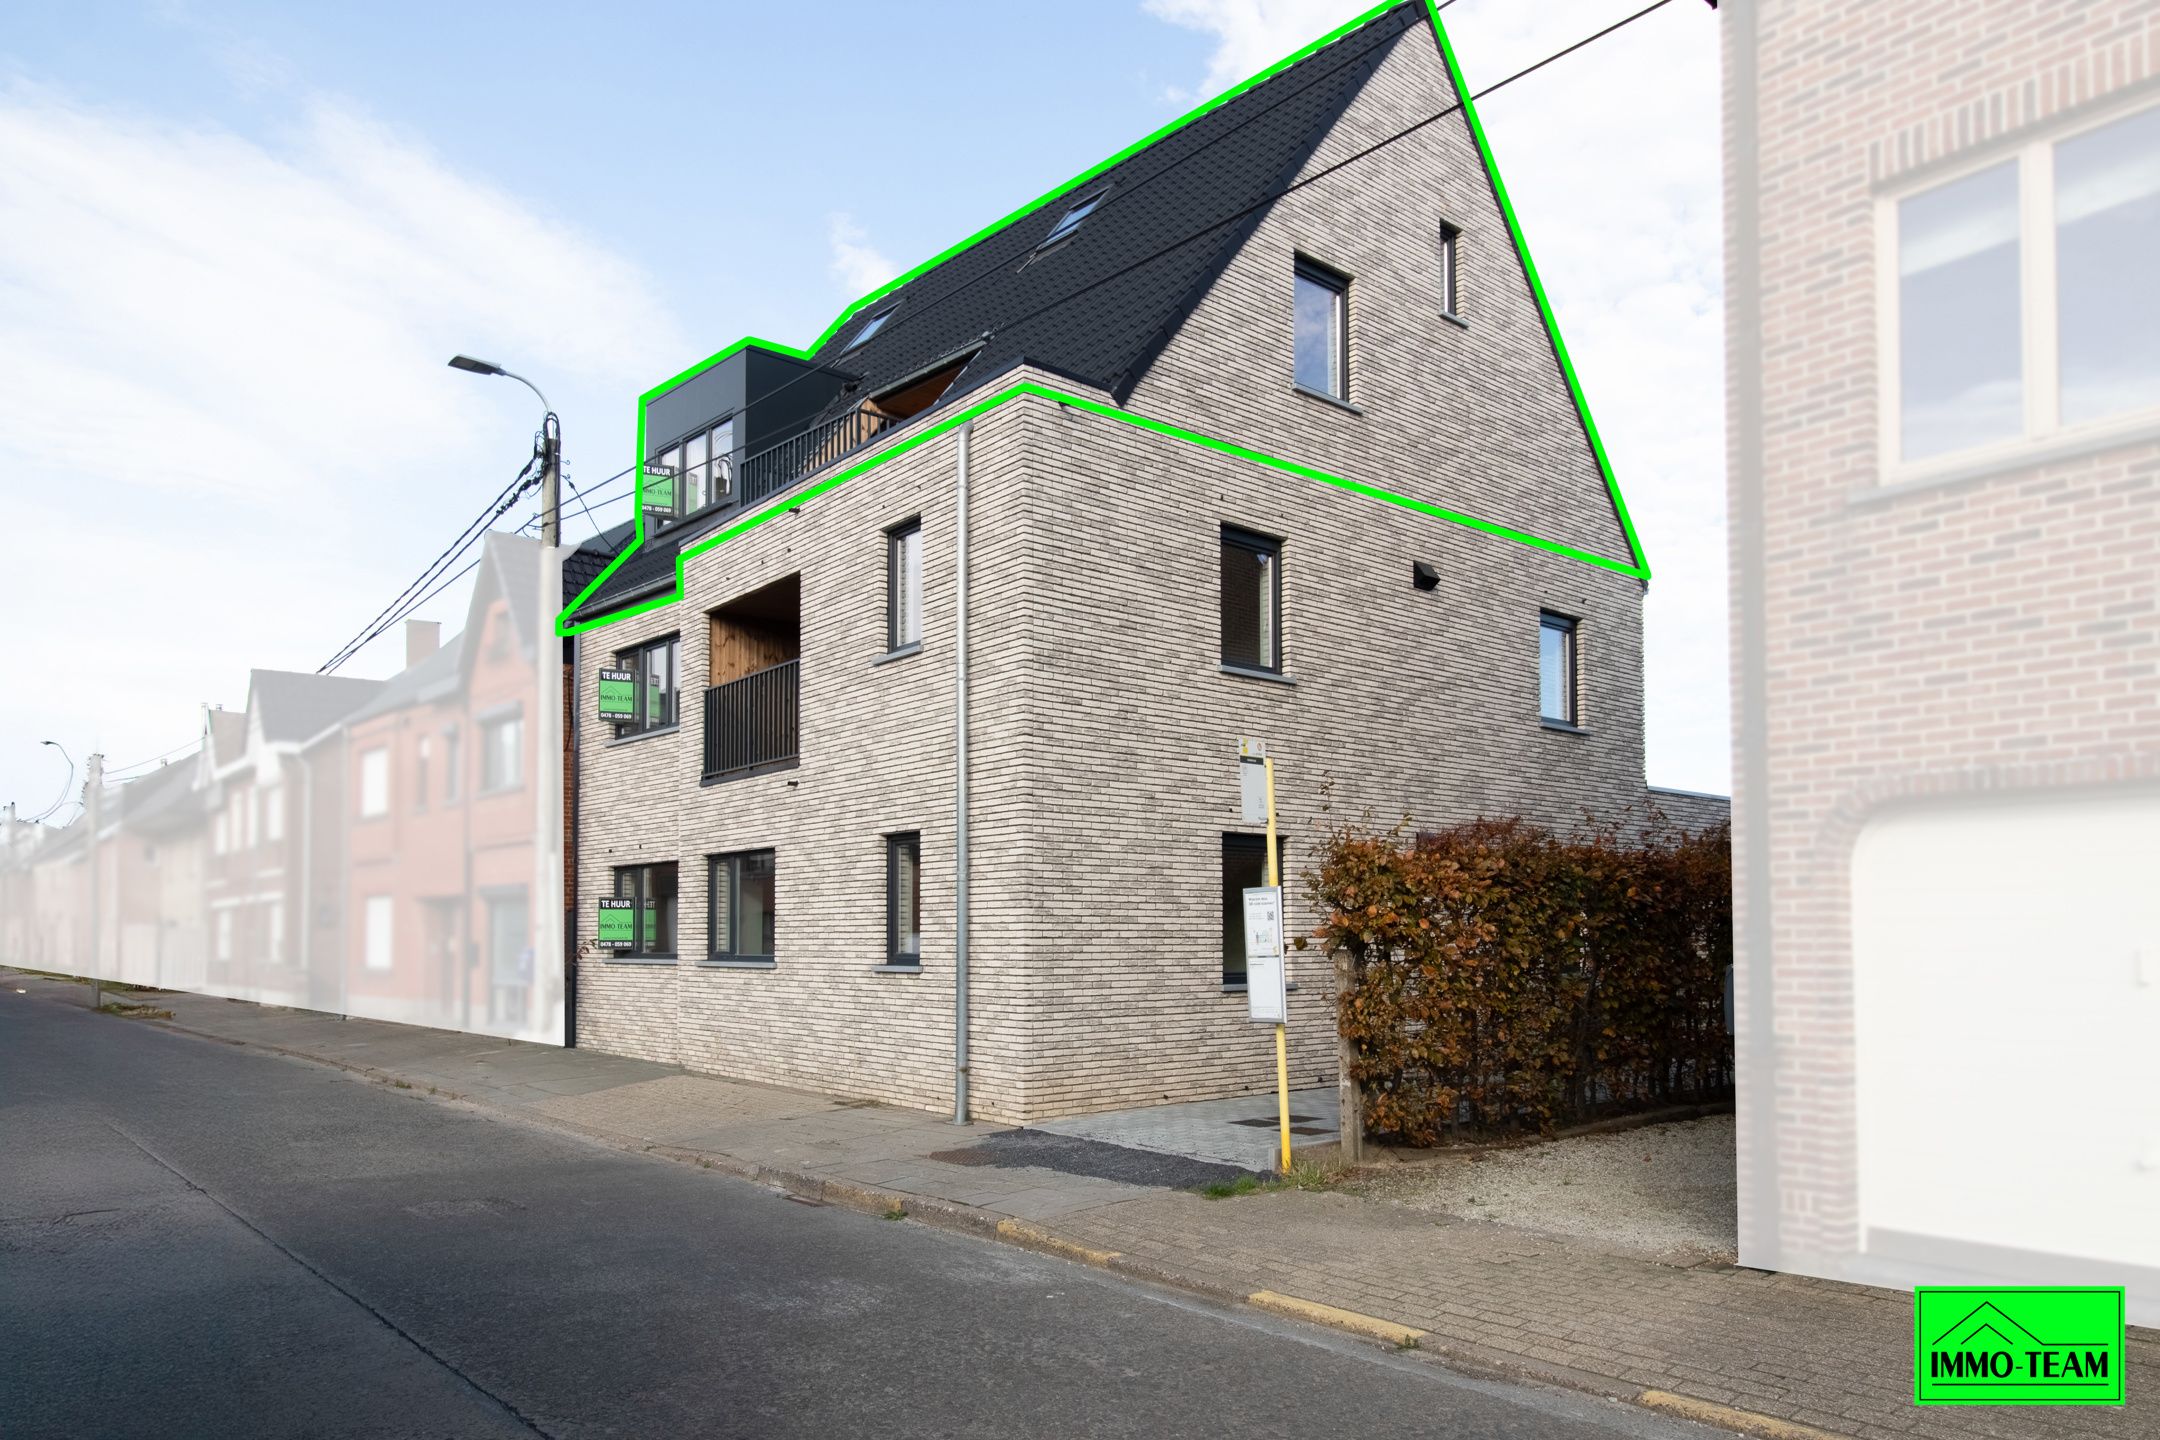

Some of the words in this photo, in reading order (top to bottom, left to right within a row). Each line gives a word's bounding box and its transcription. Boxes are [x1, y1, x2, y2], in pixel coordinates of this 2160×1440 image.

[651, 466, 671, 476] HUUR
[602, 671, 610, 679] TE
[611, 671, 631, 681] HUUR
[601, 900, 610, 908] TE
[610, 900, 631, 908] HUUR
